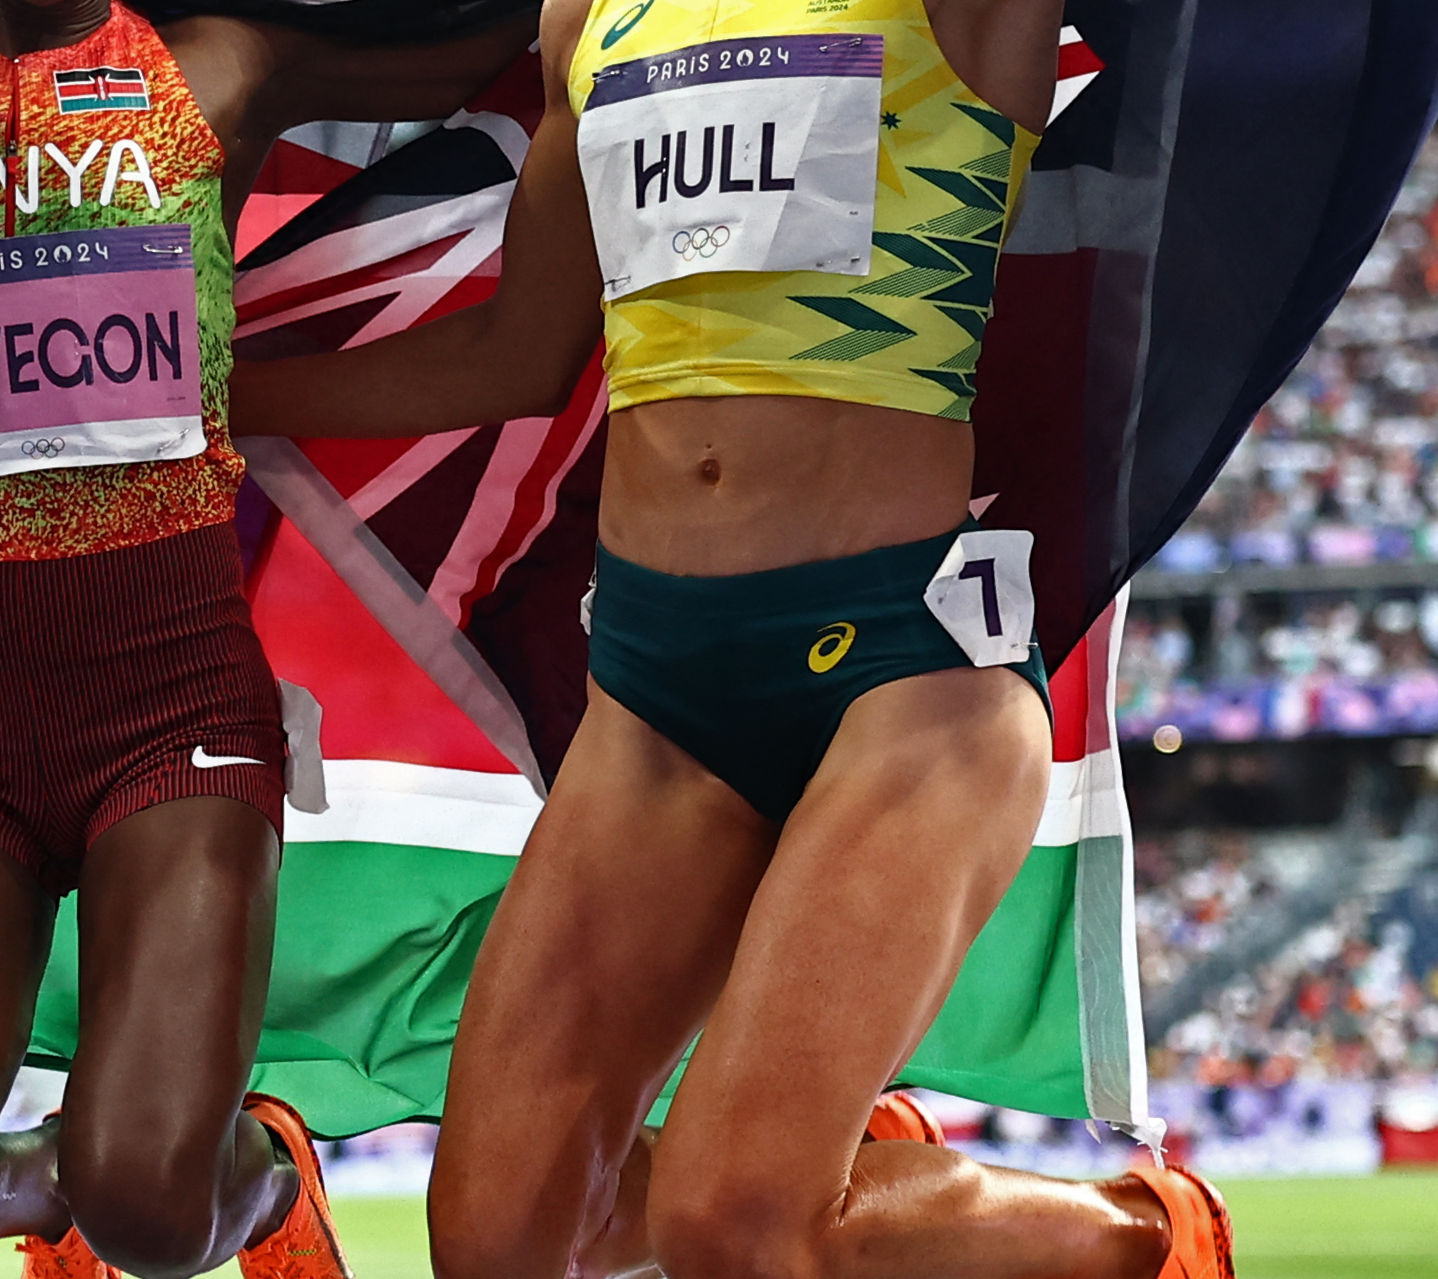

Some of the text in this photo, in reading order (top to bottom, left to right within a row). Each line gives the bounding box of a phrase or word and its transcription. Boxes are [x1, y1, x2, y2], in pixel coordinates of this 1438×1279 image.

[829, 4, 848, 12] 2024
[719, 46, 791, 70] 2024
[633, 121, 796, 210] HULL
[34, 243, 110, 268] 2024
